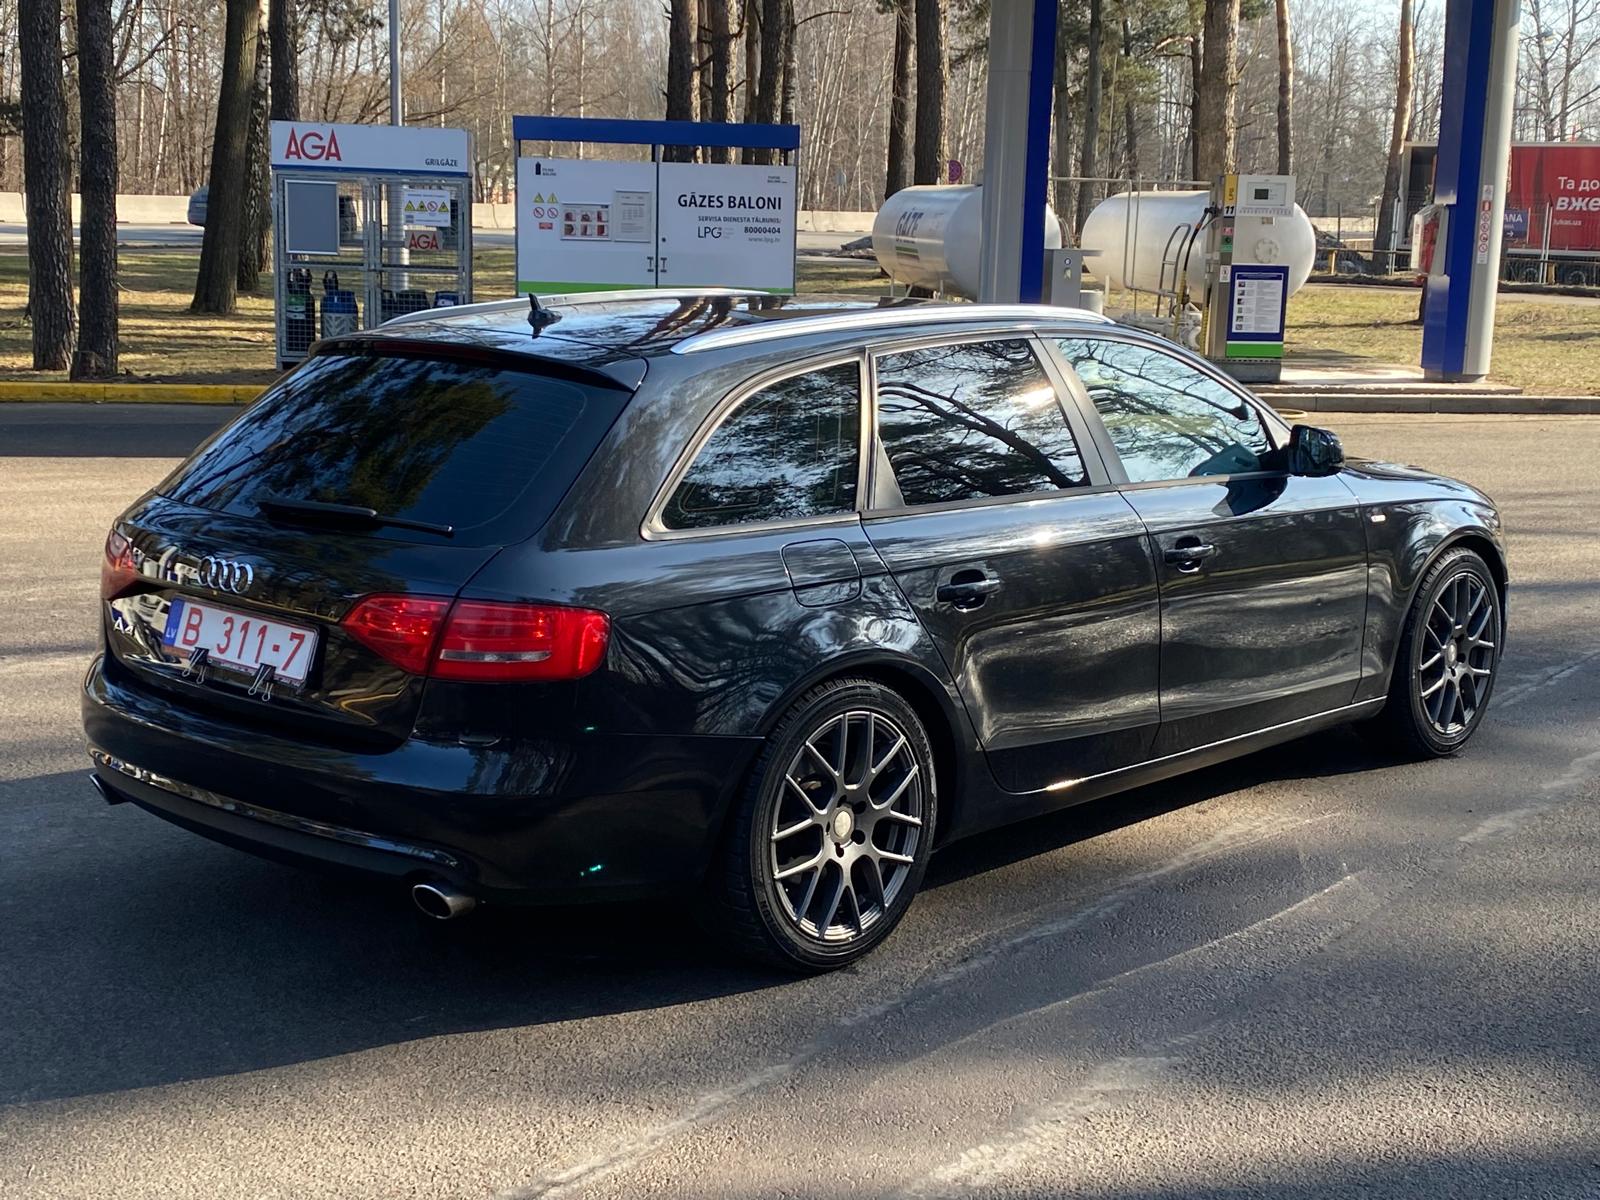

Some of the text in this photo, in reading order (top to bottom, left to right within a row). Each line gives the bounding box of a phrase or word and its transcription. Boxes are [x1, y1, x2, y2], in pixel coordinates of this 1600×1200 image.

[285, 127, 342, 161] AGA
[1558, 176, 1575, 190] Та
[678, 192, 782, 210] GĀZES BALONI
[1225, 206, 1235, 214] 11
[697, 226, 722, 239] LPG
[744, 226, 781, 234] 80000404
[409, 232, 439, 250] AGA
[165, 626, 177, 638] LV
[182, 607, 305, 671] B 311-7
